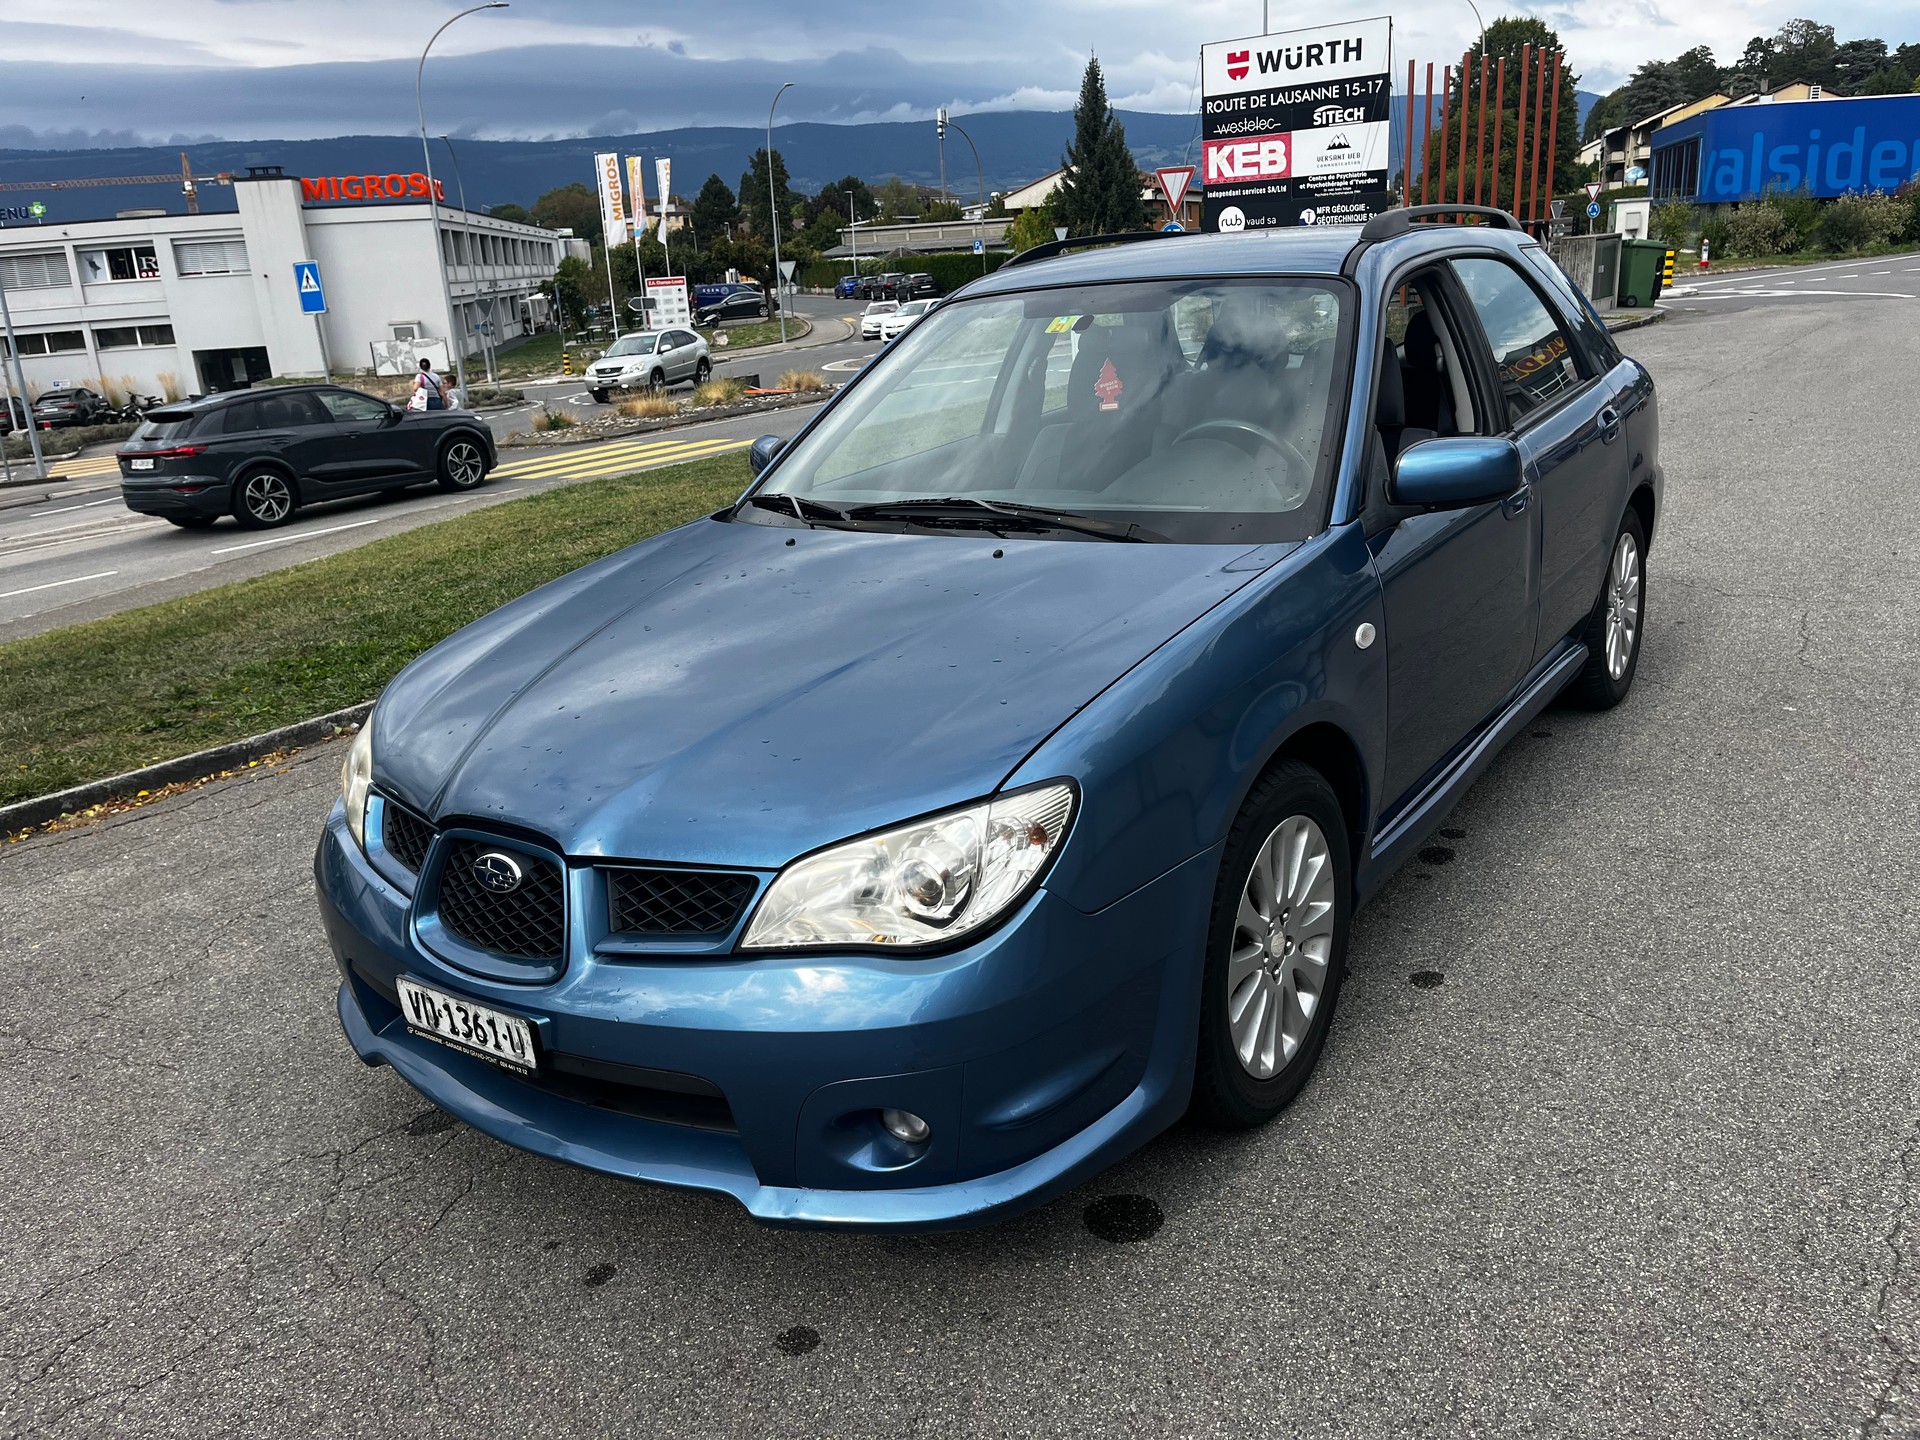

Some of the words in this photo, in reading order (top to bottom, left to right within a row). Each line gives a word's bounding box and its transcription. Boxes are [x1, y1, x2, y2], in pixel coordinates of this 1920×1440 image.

[1256, 37, 1362, 74] WÜRTH
[1206, 97, 1247, 114] ROUTE
[1250, 94, 1266, 108] DE
[1271, 85, 1340, 106] LAUSANNE
[1344, 79, 1383, 97] 15-17
[1213, 116, 1281, 134] westelec
[1313, 106, 1365, 126] SITECH
[1208, 140, 1287, 179] KEB
[1316, 154, 1345, 162] VERSANT
[1336, 171, 1367, 180] Psychiatrie
[301, 172, 428, 201] MIGROS
[606, 157, 623, 222] MIGROS
[1242, 186, 1266, 196] services
[1316, 206, 1331, 214] MFR
[1331, 203, 1366, 214] GÉOLOGIE
[1246, 216, 1265, 226] vaud
[1266, 217, 1277, 225] sa
[1316, 213, 1368, 225] GÉOTECHNIQUE
